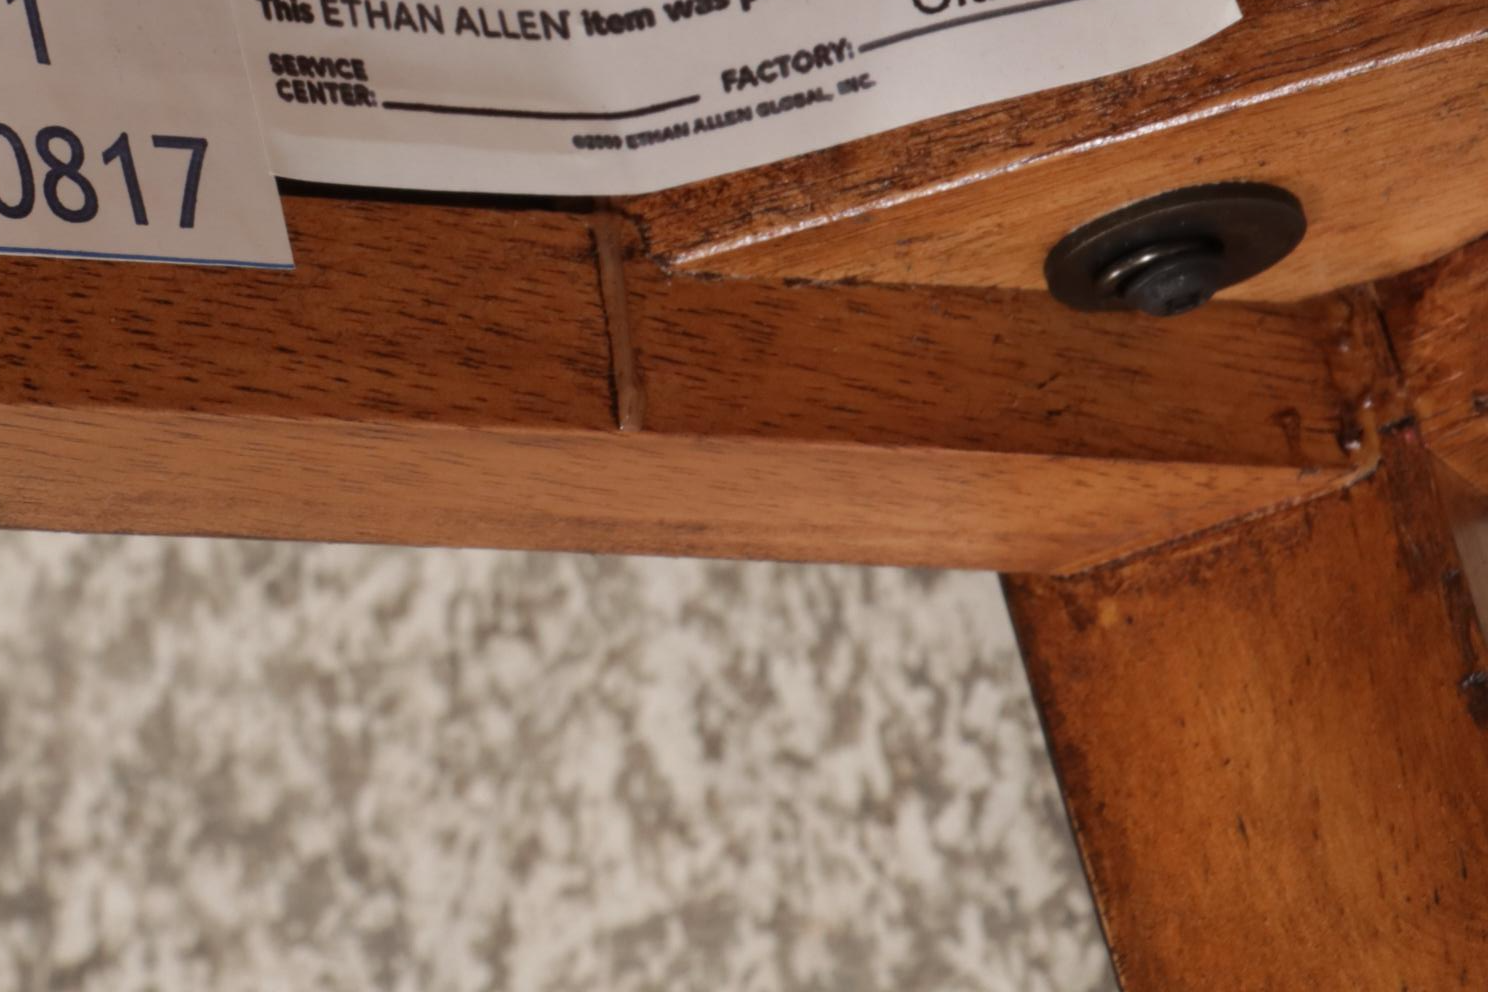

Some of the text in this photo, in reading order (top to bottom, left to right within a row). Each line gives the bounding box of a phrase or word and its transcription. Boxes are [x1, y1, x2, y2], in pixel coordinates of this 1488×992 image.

[580, 8, 657, 38] item
[268, 52, 370, 82] SERVICE
[720, 36, 856, 94] FACTORY:
[275, 78, 379, 107] CENTER:
[625, 121, 690, 150] ETHAN
[692, 106, 754, 134] ALLEN
